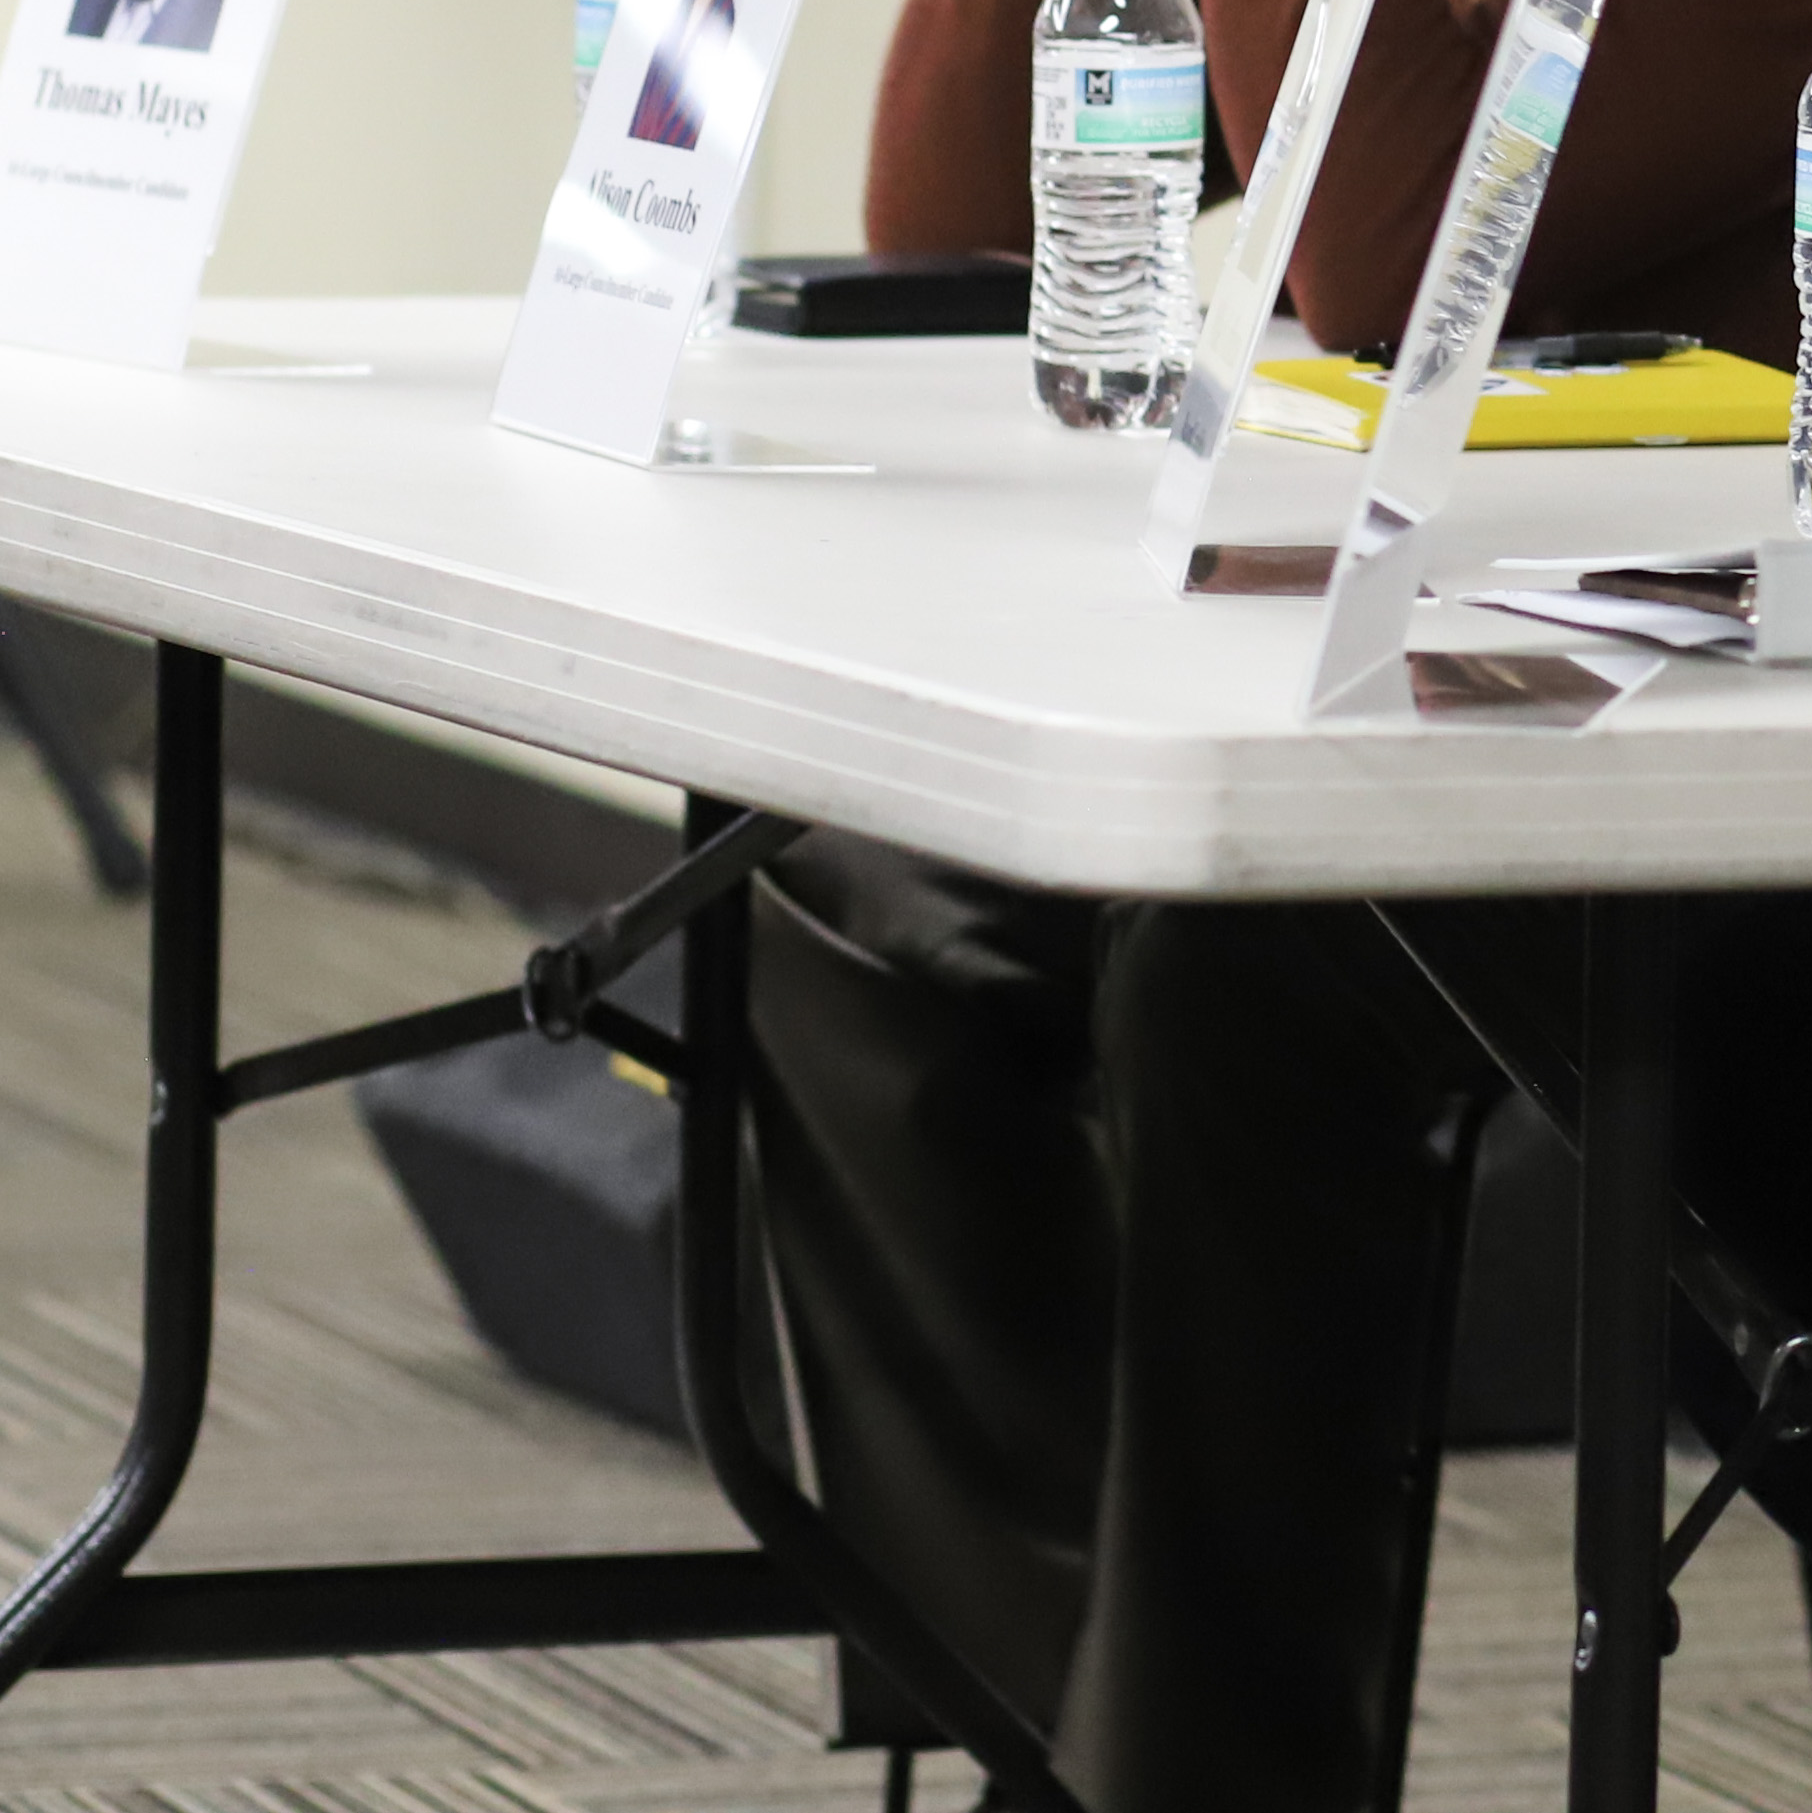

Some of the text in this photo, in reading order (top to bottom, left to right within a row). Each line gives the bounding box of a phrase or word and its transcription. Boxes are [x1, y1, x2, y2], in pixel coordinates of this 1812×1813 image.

[34, 67, 210, 138] Thomas Mayes
[633, 178, 701, 234] Coombs
